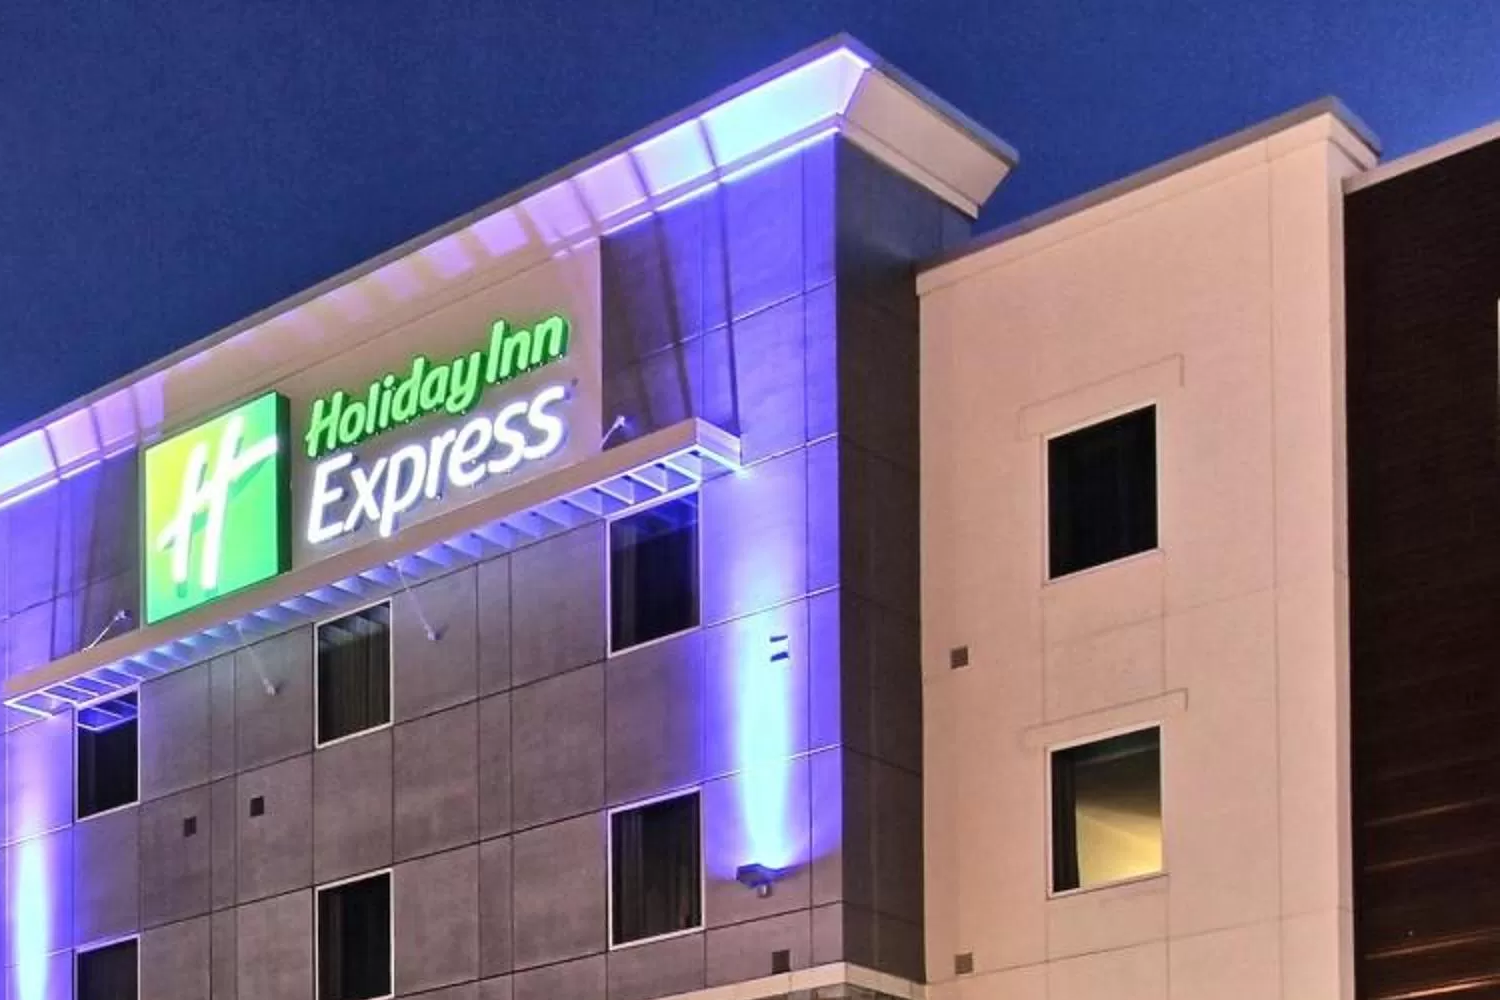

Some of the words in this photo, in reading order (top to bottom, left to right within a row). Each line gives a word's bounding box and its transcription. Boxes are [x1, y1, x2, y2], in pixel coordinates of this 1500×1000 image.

[304, 350, 484, 458] Holiday
[485, 315, 566, 384] Inn
[306, 385, 566, 544] Express
